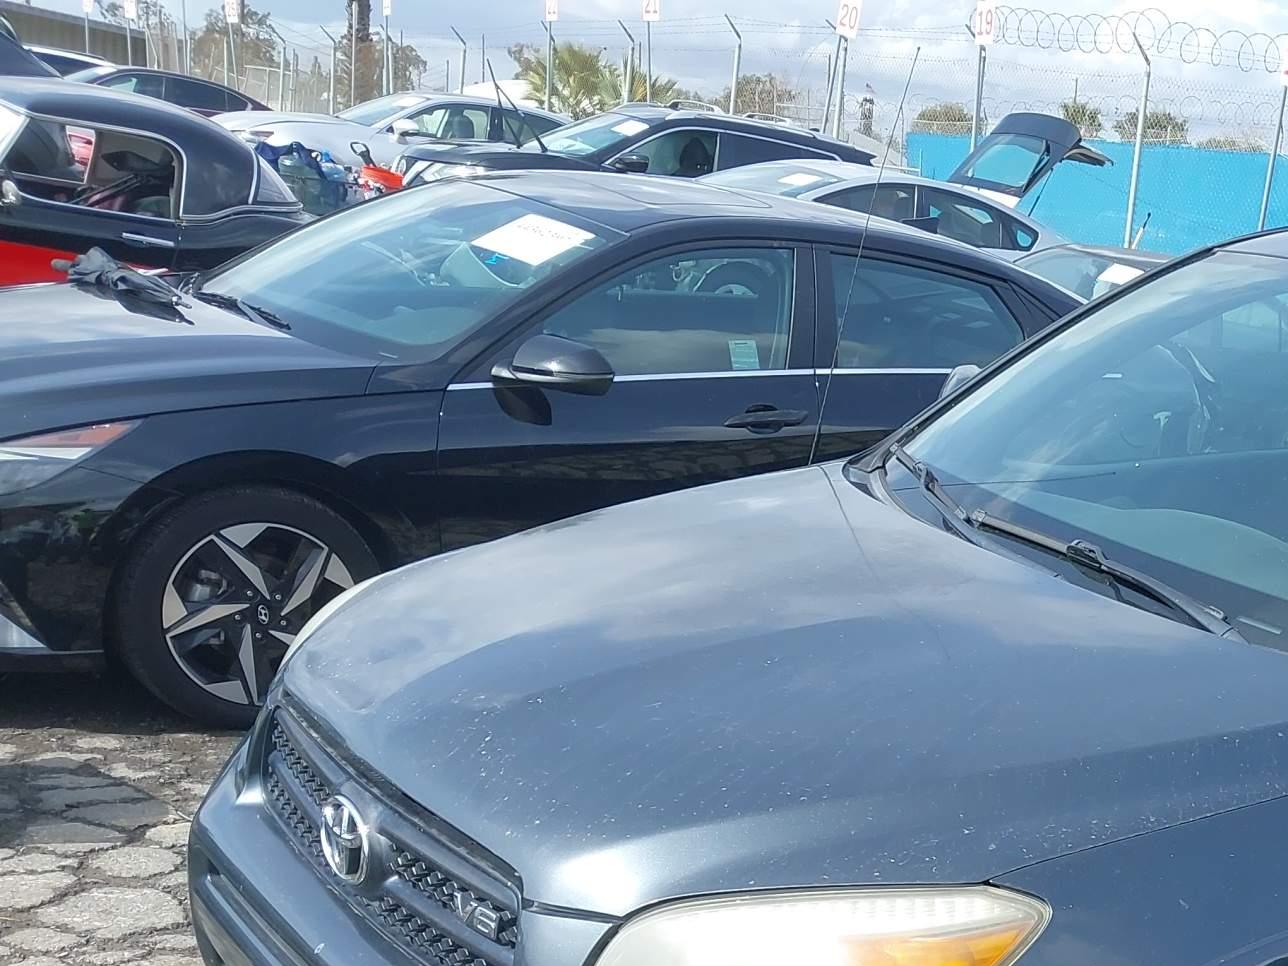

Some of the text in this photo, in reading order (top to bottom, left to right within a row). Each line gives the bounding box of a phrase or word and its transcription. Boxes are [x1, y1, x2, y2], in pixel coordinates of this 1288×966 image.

[839, 4, 858, 30] 20
[976, 9, 993, 36] 19
[452, 891, 499, 940] V6
